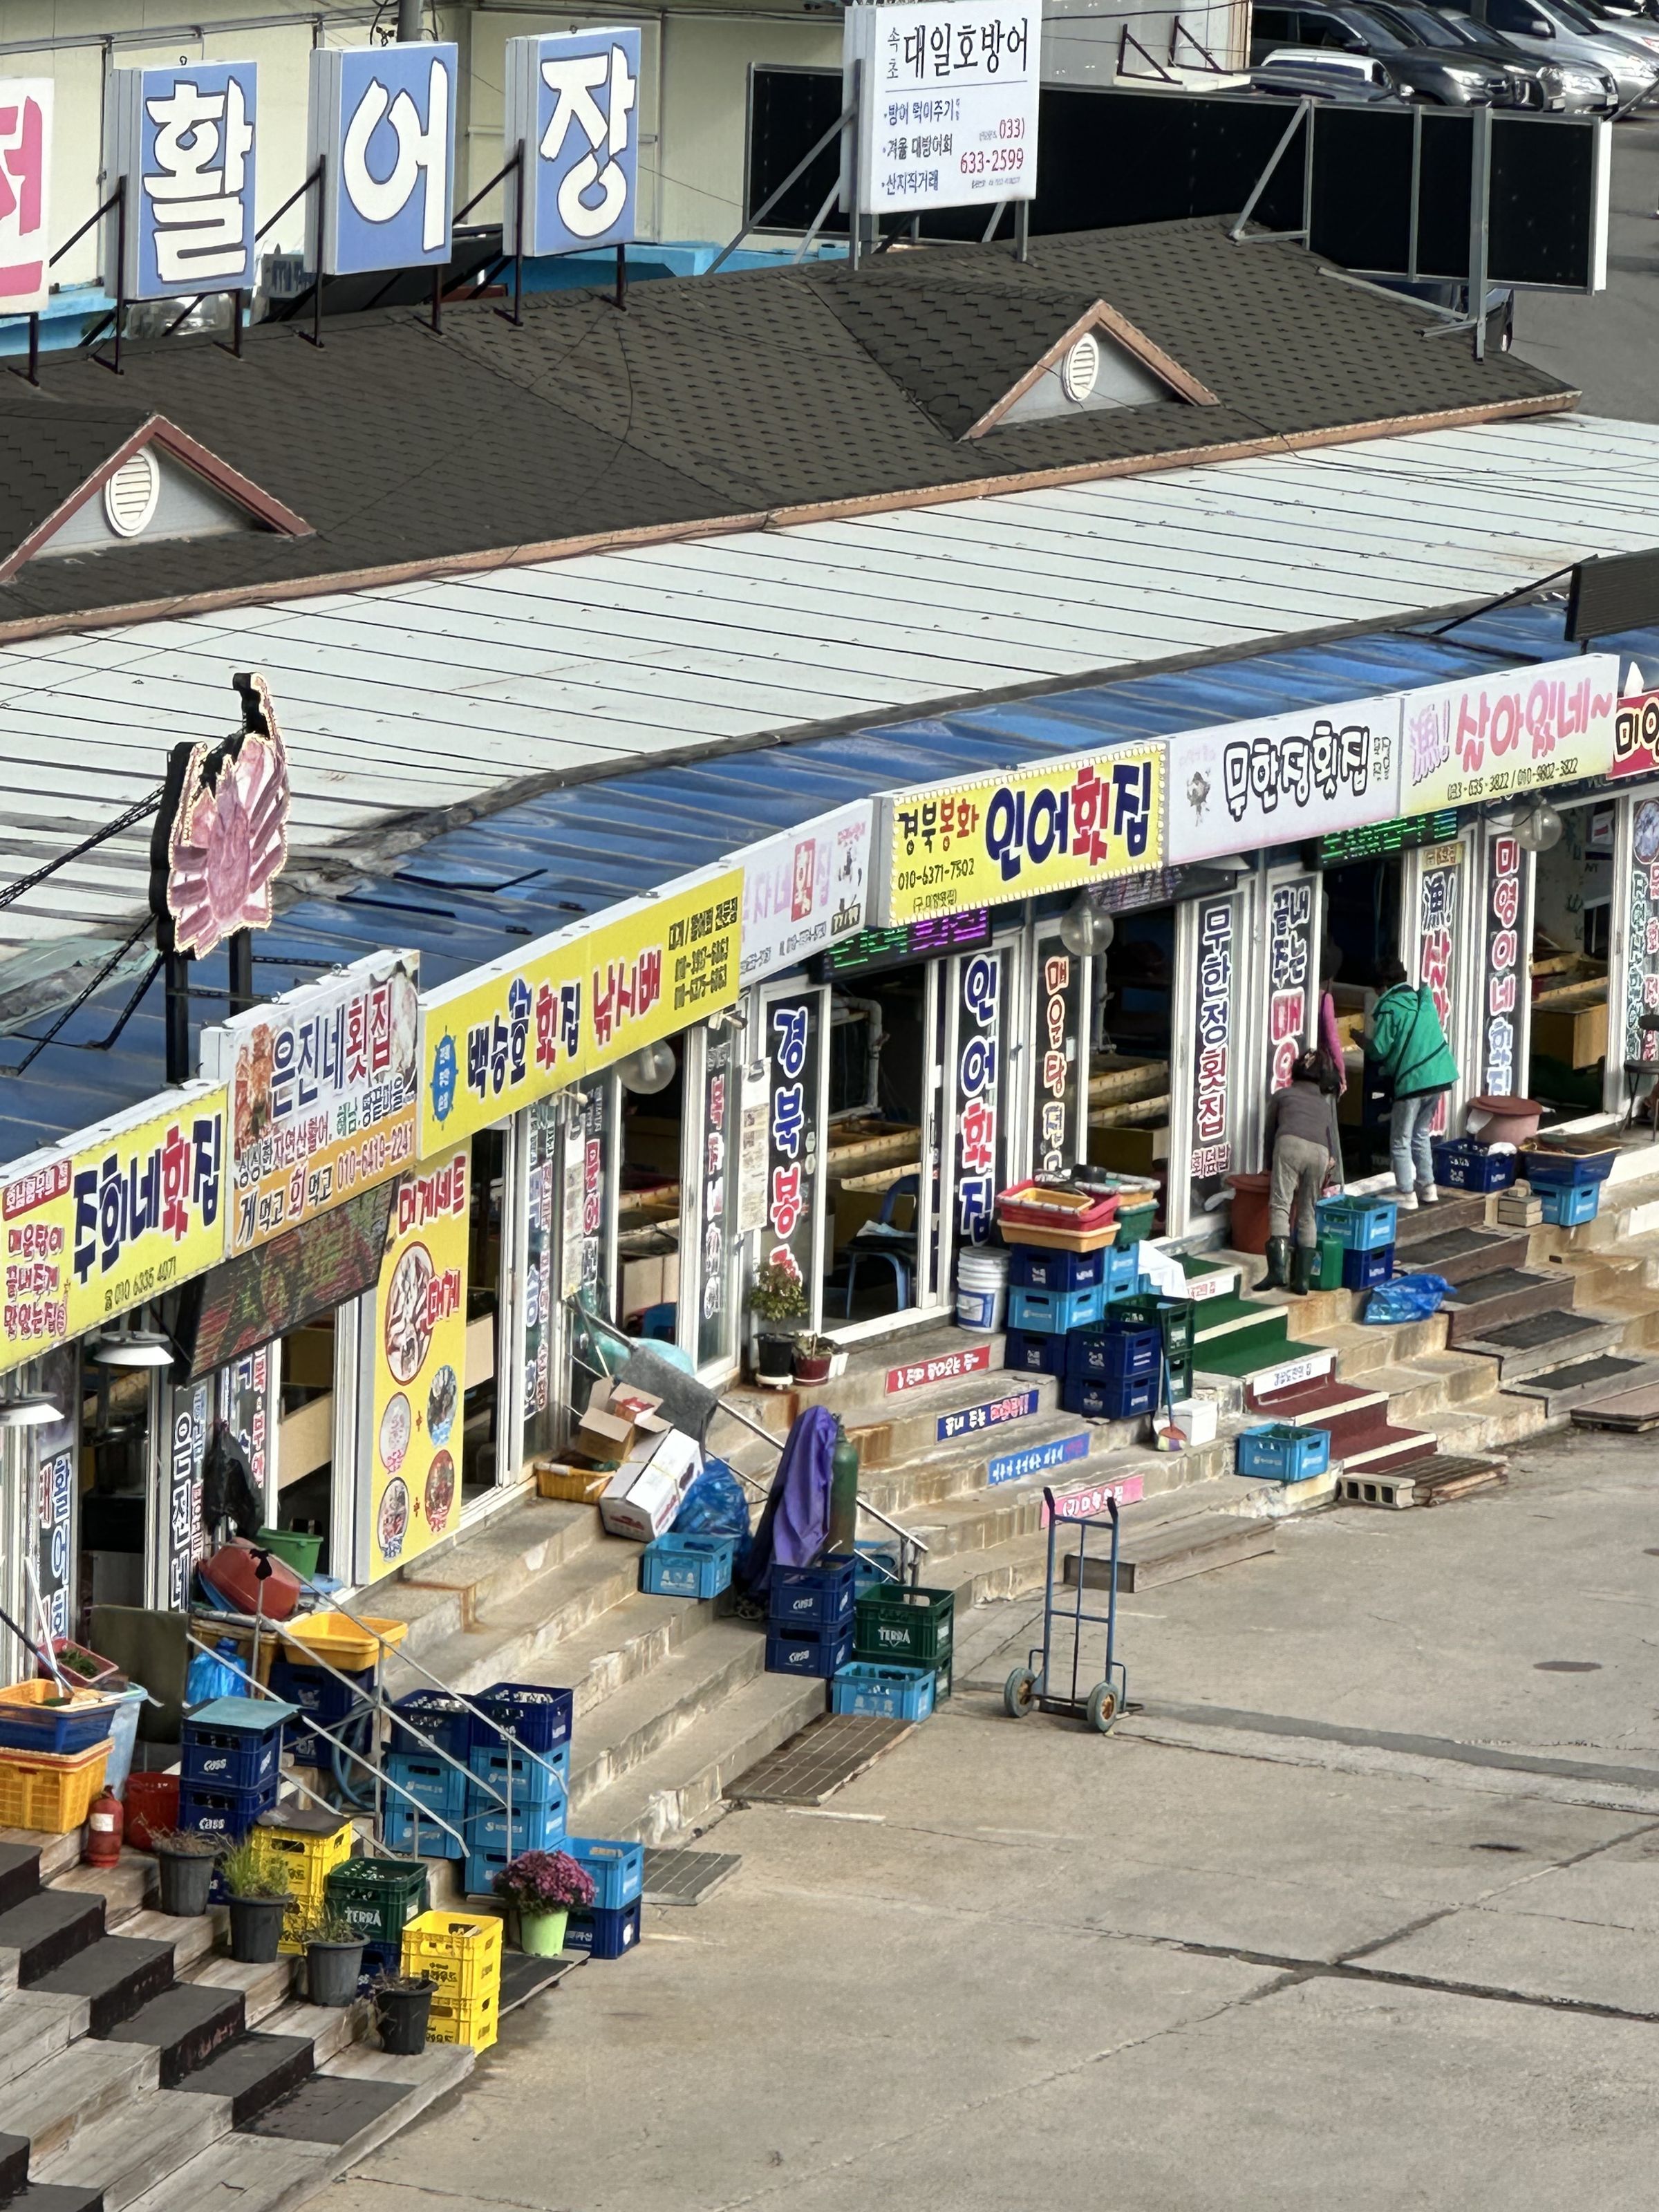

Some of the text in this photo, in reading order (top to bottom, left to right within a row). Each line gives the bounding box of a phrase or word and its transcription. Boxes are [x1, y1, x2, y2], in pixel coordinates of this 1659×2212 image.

[887, 27, 900, 79] 속초
[903, 17, 1028, 79] 대일호방어
[960, 147, 1024, 174] 633-2599
[271, 982, 393, 1117] 은진네횟집
[1044, 955, 1070, 1098] 매운탕
[1197, 903, 1233, 1141] 무한정횟집
[877, 1626, 911, 1644] TERRA
[198, 1817, 225, 1830] Cass
